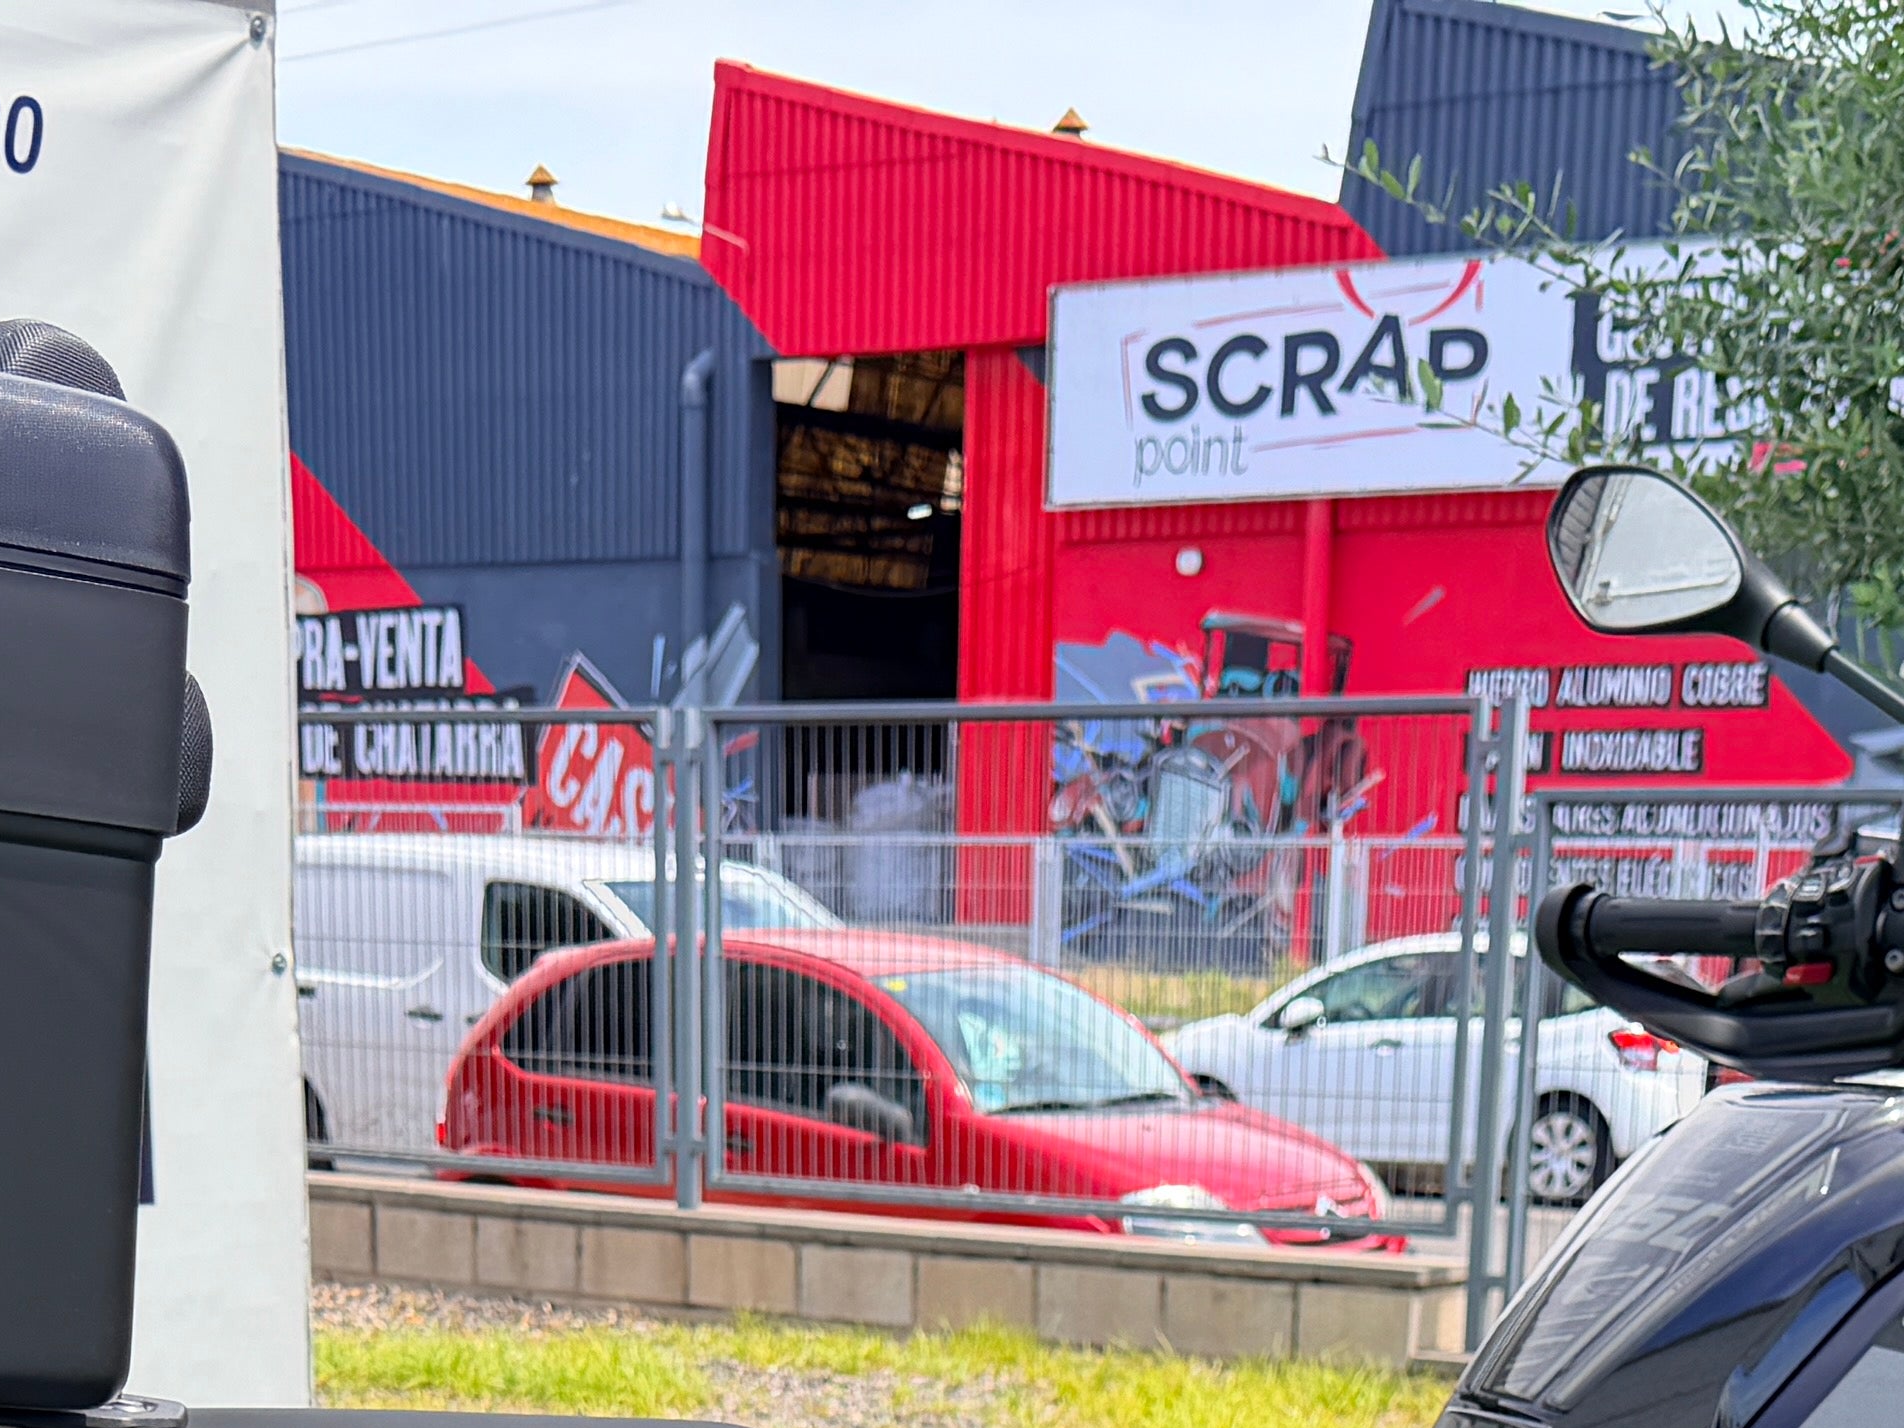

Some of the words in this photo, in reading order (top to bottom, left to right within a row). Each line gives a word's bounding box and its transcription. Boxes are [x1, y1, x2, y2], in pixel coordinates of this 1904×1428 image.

[1140, 314, 1490, 424] SCRAP
[1133, 424, 1250, 484] point
[1555, 664, 1672, 707] ALUMINIO
[1682, 661, 1767, 707] COBRE
[354, 700, 525, 777] CHATARRA
[1560, 730, 1702, 773] INOXIDABLE
